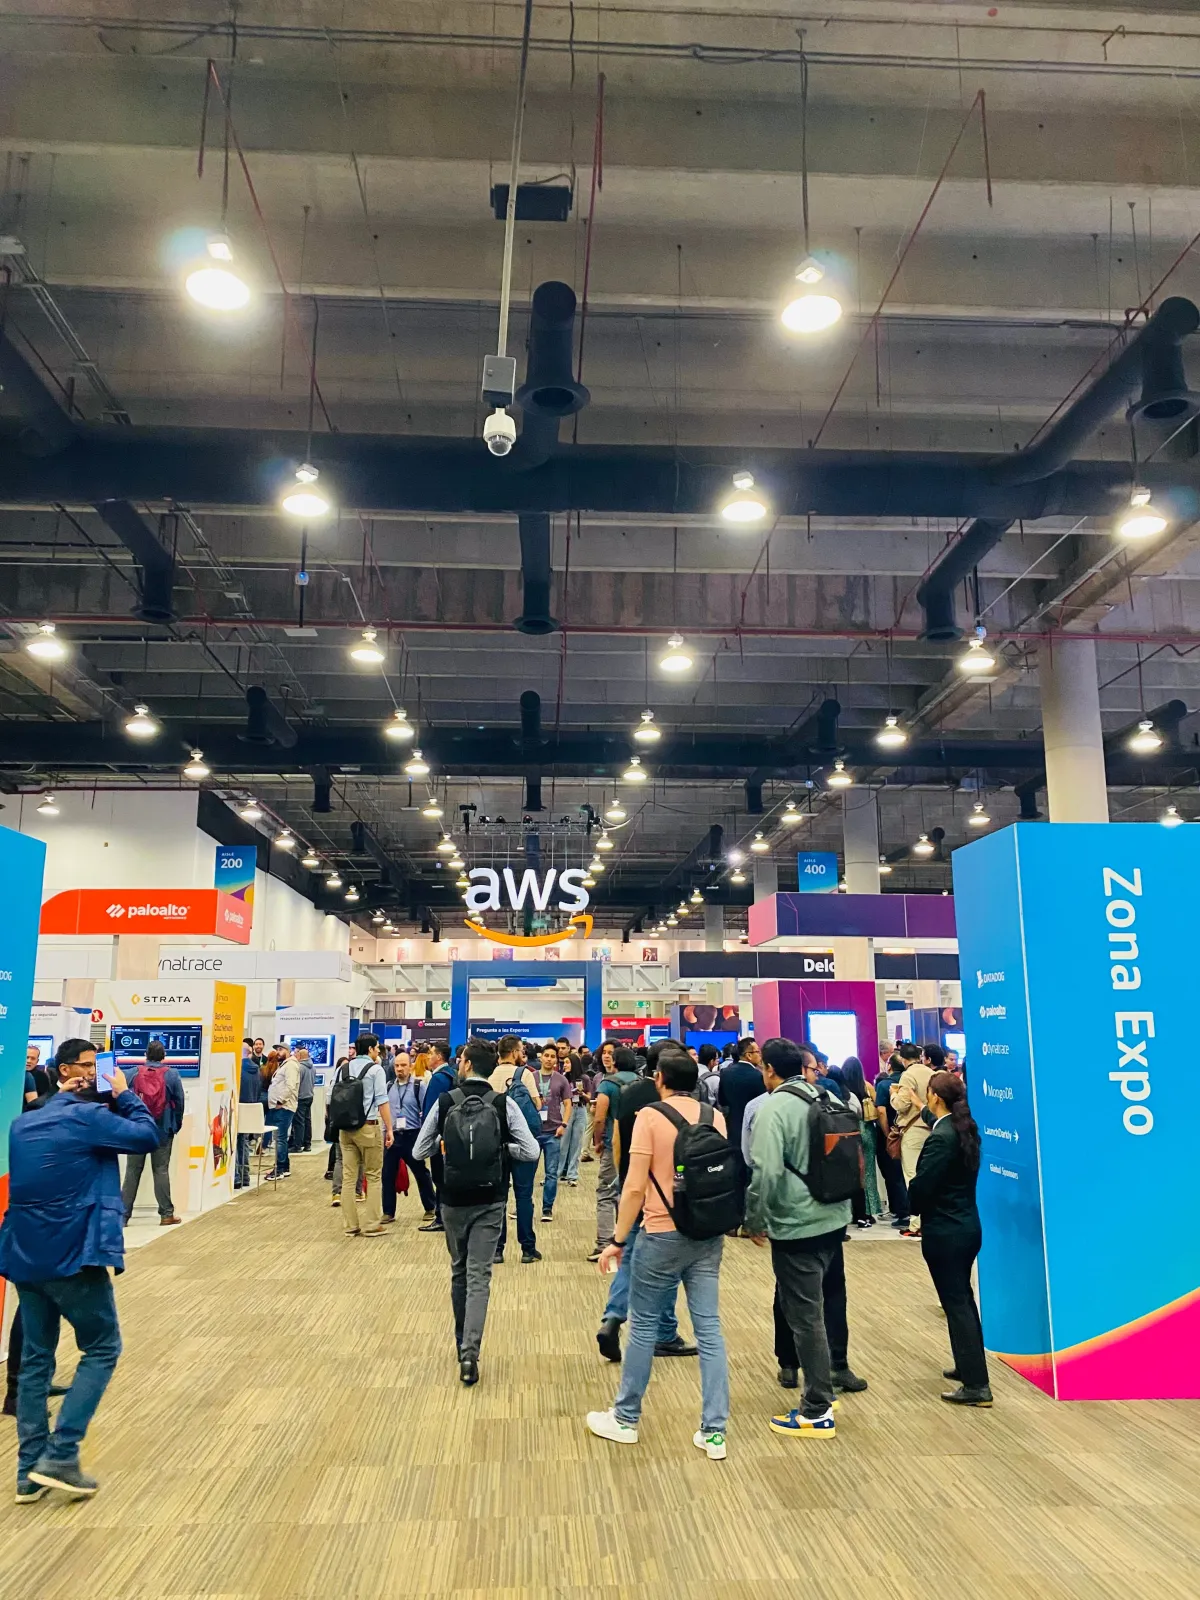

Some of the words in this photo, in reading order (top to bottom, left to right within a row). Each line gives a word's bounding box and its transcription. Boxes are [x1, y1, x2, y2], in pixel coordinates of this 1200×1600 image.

[221, 858, 243, 869] 200
[804, 864, 826, 875] 400
[465, 867, 590, 912] aws
[127, 904, 188, 919] paloalto
[1102, 867, 1143, 991] Zona
[983, 971, 1005, 984] DATADOG
[987, 1042, 1010, 1056] dynatrace
[1108, 1011, 1156, 1136] Expo
[987, 1085, 1013, 1102] MongoDB
[983, 1125, 1012, 1142] LaunchDarkly
